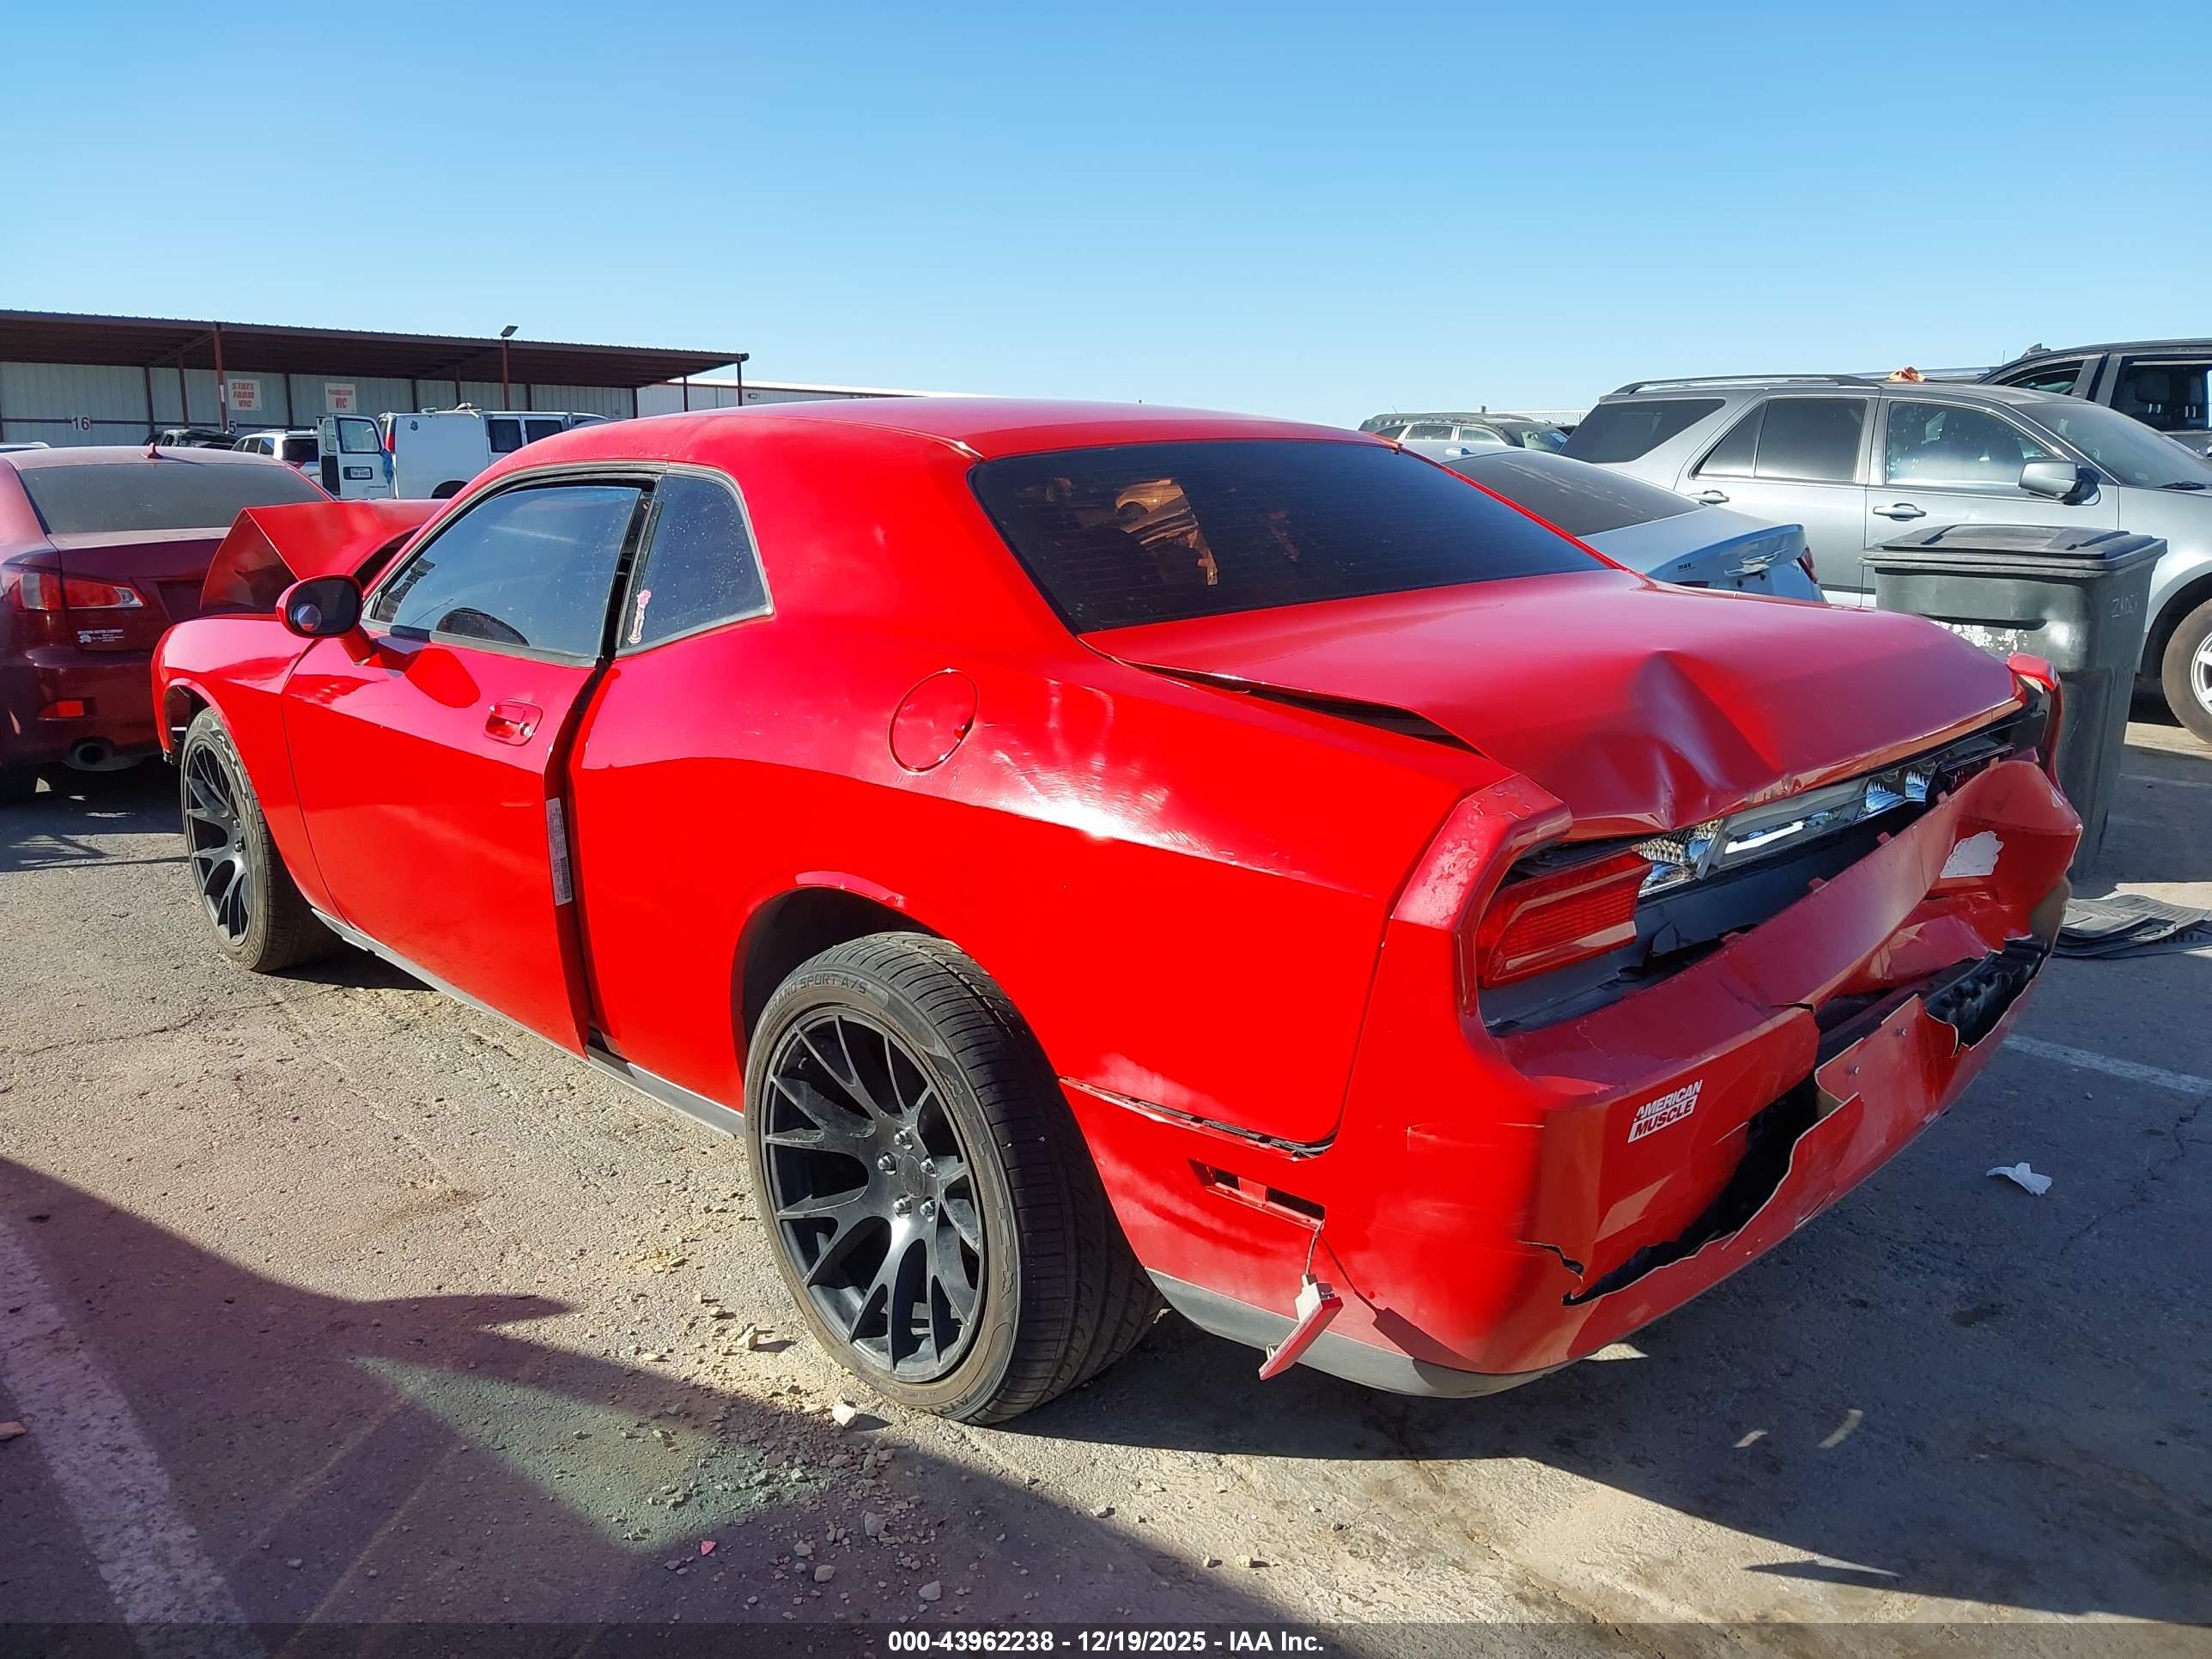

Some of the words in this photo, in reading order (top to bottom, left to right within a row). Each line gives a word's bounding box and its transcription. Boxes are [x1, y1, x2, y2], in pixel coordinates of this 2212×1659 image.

[239, 399, 252, 408] VIC
[335, 398, 348, 409] VIC
[72, 416, 90, 430] 16
[767, 981, 798, 1018] GRAND
[799, 973, 839, 989] SPORT
[841, 975, 869, 995] A/S
[1633, 1079, 1704, 1122] AMERICAN
[1632, 1097, 1695, 1139] MUSCLE
